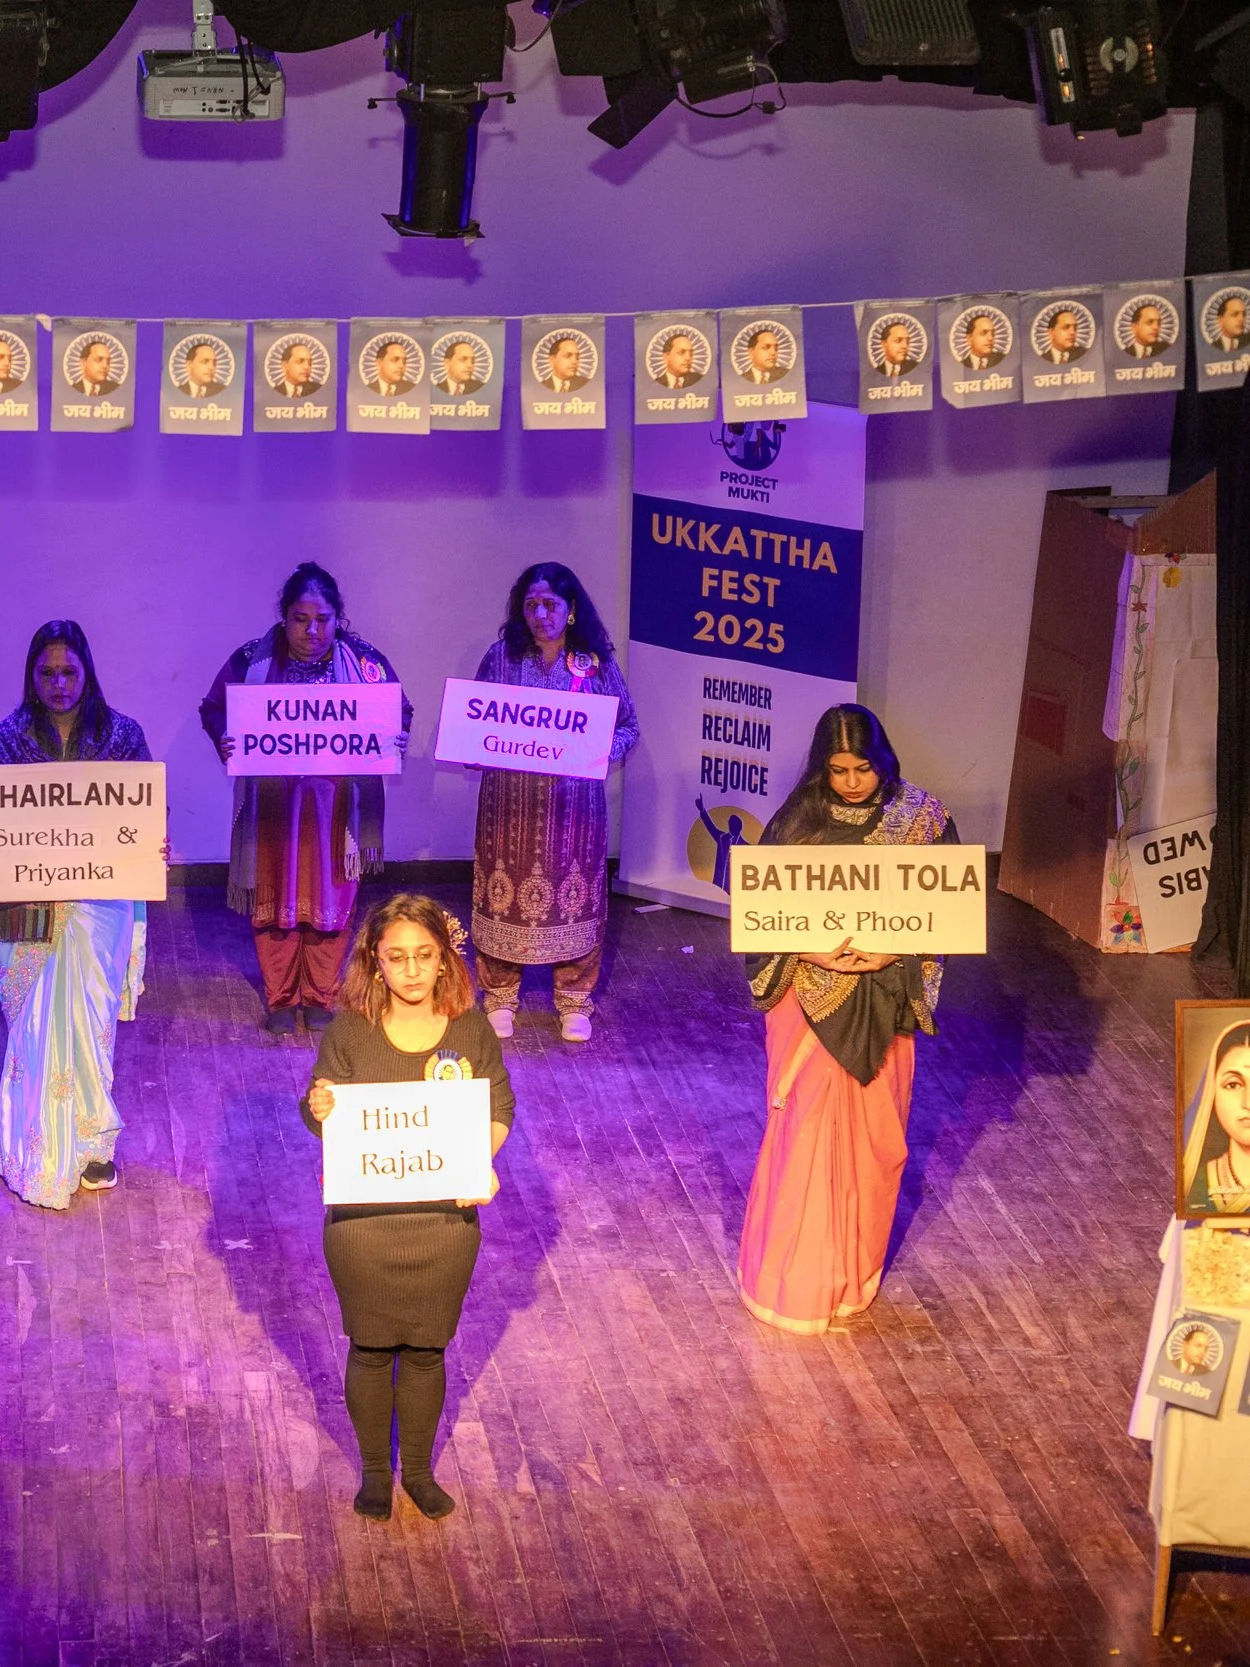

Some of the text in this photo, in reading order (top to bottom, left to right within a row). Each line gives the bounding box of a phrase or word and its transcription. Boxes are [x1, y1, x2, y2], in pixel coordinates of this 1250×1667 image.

[1033, 367, 1095, 387] जय भीम
[1115, 362, 1176, 380] जय भीम
[1205, 360, 1233, 376] जय
[868, 381, 924, 399] जय भीम
[952, 373, 1013, 394] जय भीम
[430, 400, 490, 417] जय भीम
[533, 397, 596, 414] जय भीम
[647, 393, 710, 410] जय भीम
[734, 388, 797, 407] जय भीम
[63, 401, 125, 419] जय भीम
[169, 403, 232, 421] जय भीम
[265, 402, 328, 419] जय भीम
[358, 402, 421, 420] जय भीम
[720, 471, 778, 490] PROJECT
[728, 487, 770, 503] MUKTI
[652, 513, 838, 574] UKKATTHA
[702, 567, 780, 608] FEST
[694, 611, 785, 654] 2025
[703, 677, 772, 710] REMEMBER
[267, 699, 357, 721] KUNAN
[466, 698, 588, 734] SANGRUR
[702, 713, 771, 752] RECLAIM
[244, 733, 381, 755] POSHPORA
[483, 735, 564, 760] Gurdev
[701, 755, 768, 797] REJOICE
[117, 826, 138, 844] &
[1143, 825, 1215, 865] WED
[14, 862, 114, 887] Priyanka
[741, 864, 981, 892] BATHANI TOLA
[744, 910, 934, 932] Saira & Phool
[362, 1105, 429, 1131] Hind
[361, 1149, 444, 1180] Rajab
[1158, 1375, 1212, 1400] जय भीम
